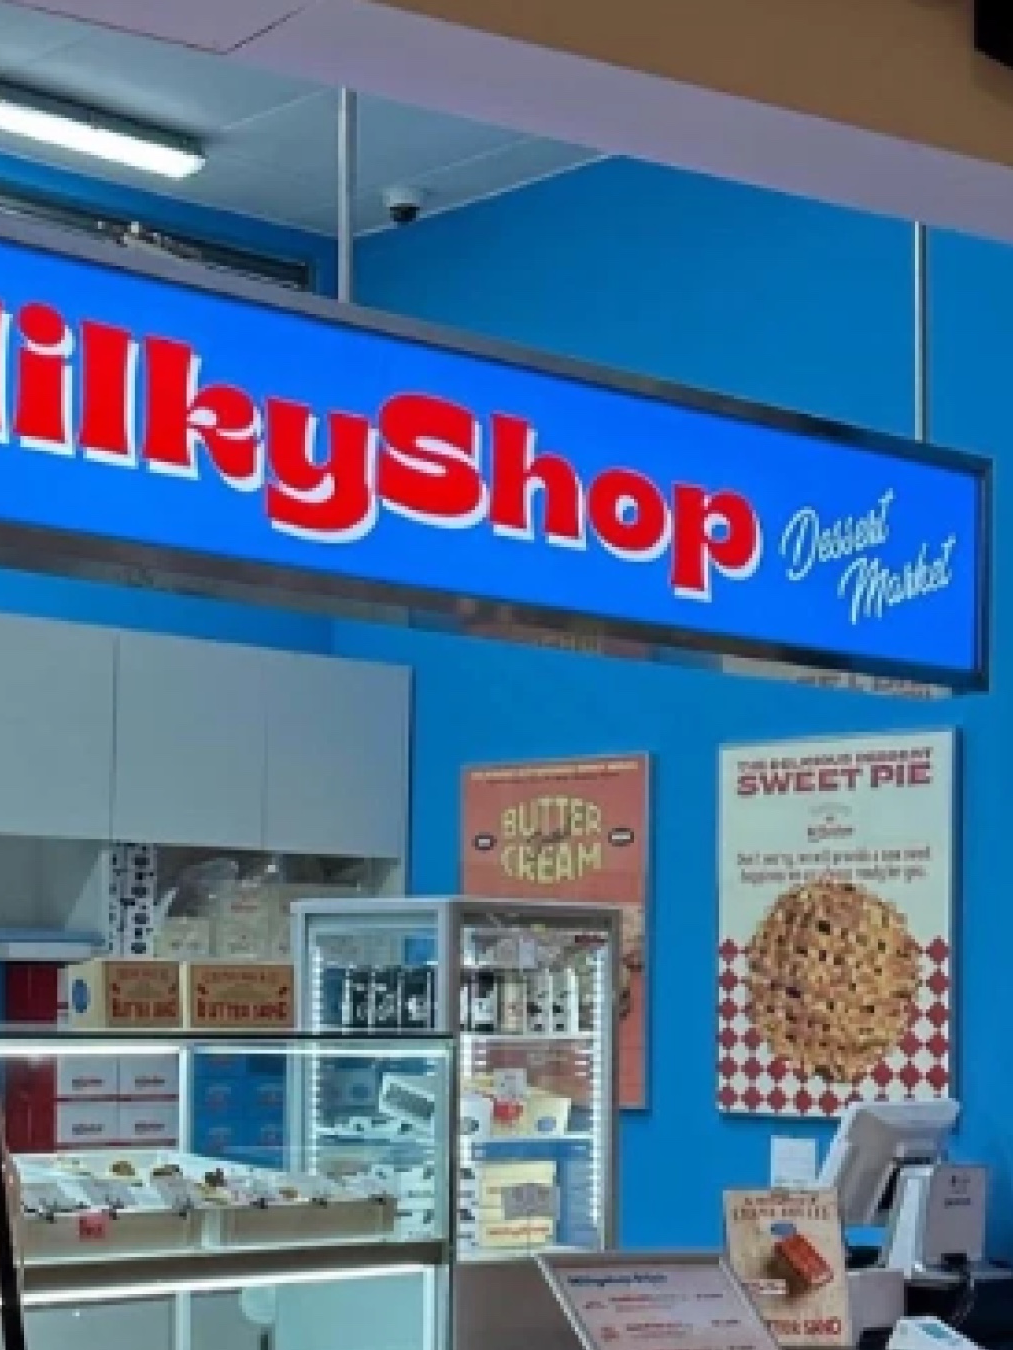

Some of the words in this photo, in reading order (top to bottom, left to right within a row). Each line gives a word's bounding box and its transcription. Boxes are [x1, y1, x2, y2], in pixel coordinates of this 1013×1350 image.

[778, 487, 893, 581] Dessert
[837, 532, 957, 626] Market
[736, 767, 862, 797] SWEET
[870, 761, 932, 789] PIE
[499, 794, 603, 837] BUTTER
[499, 840, 603, 885] CREAM
